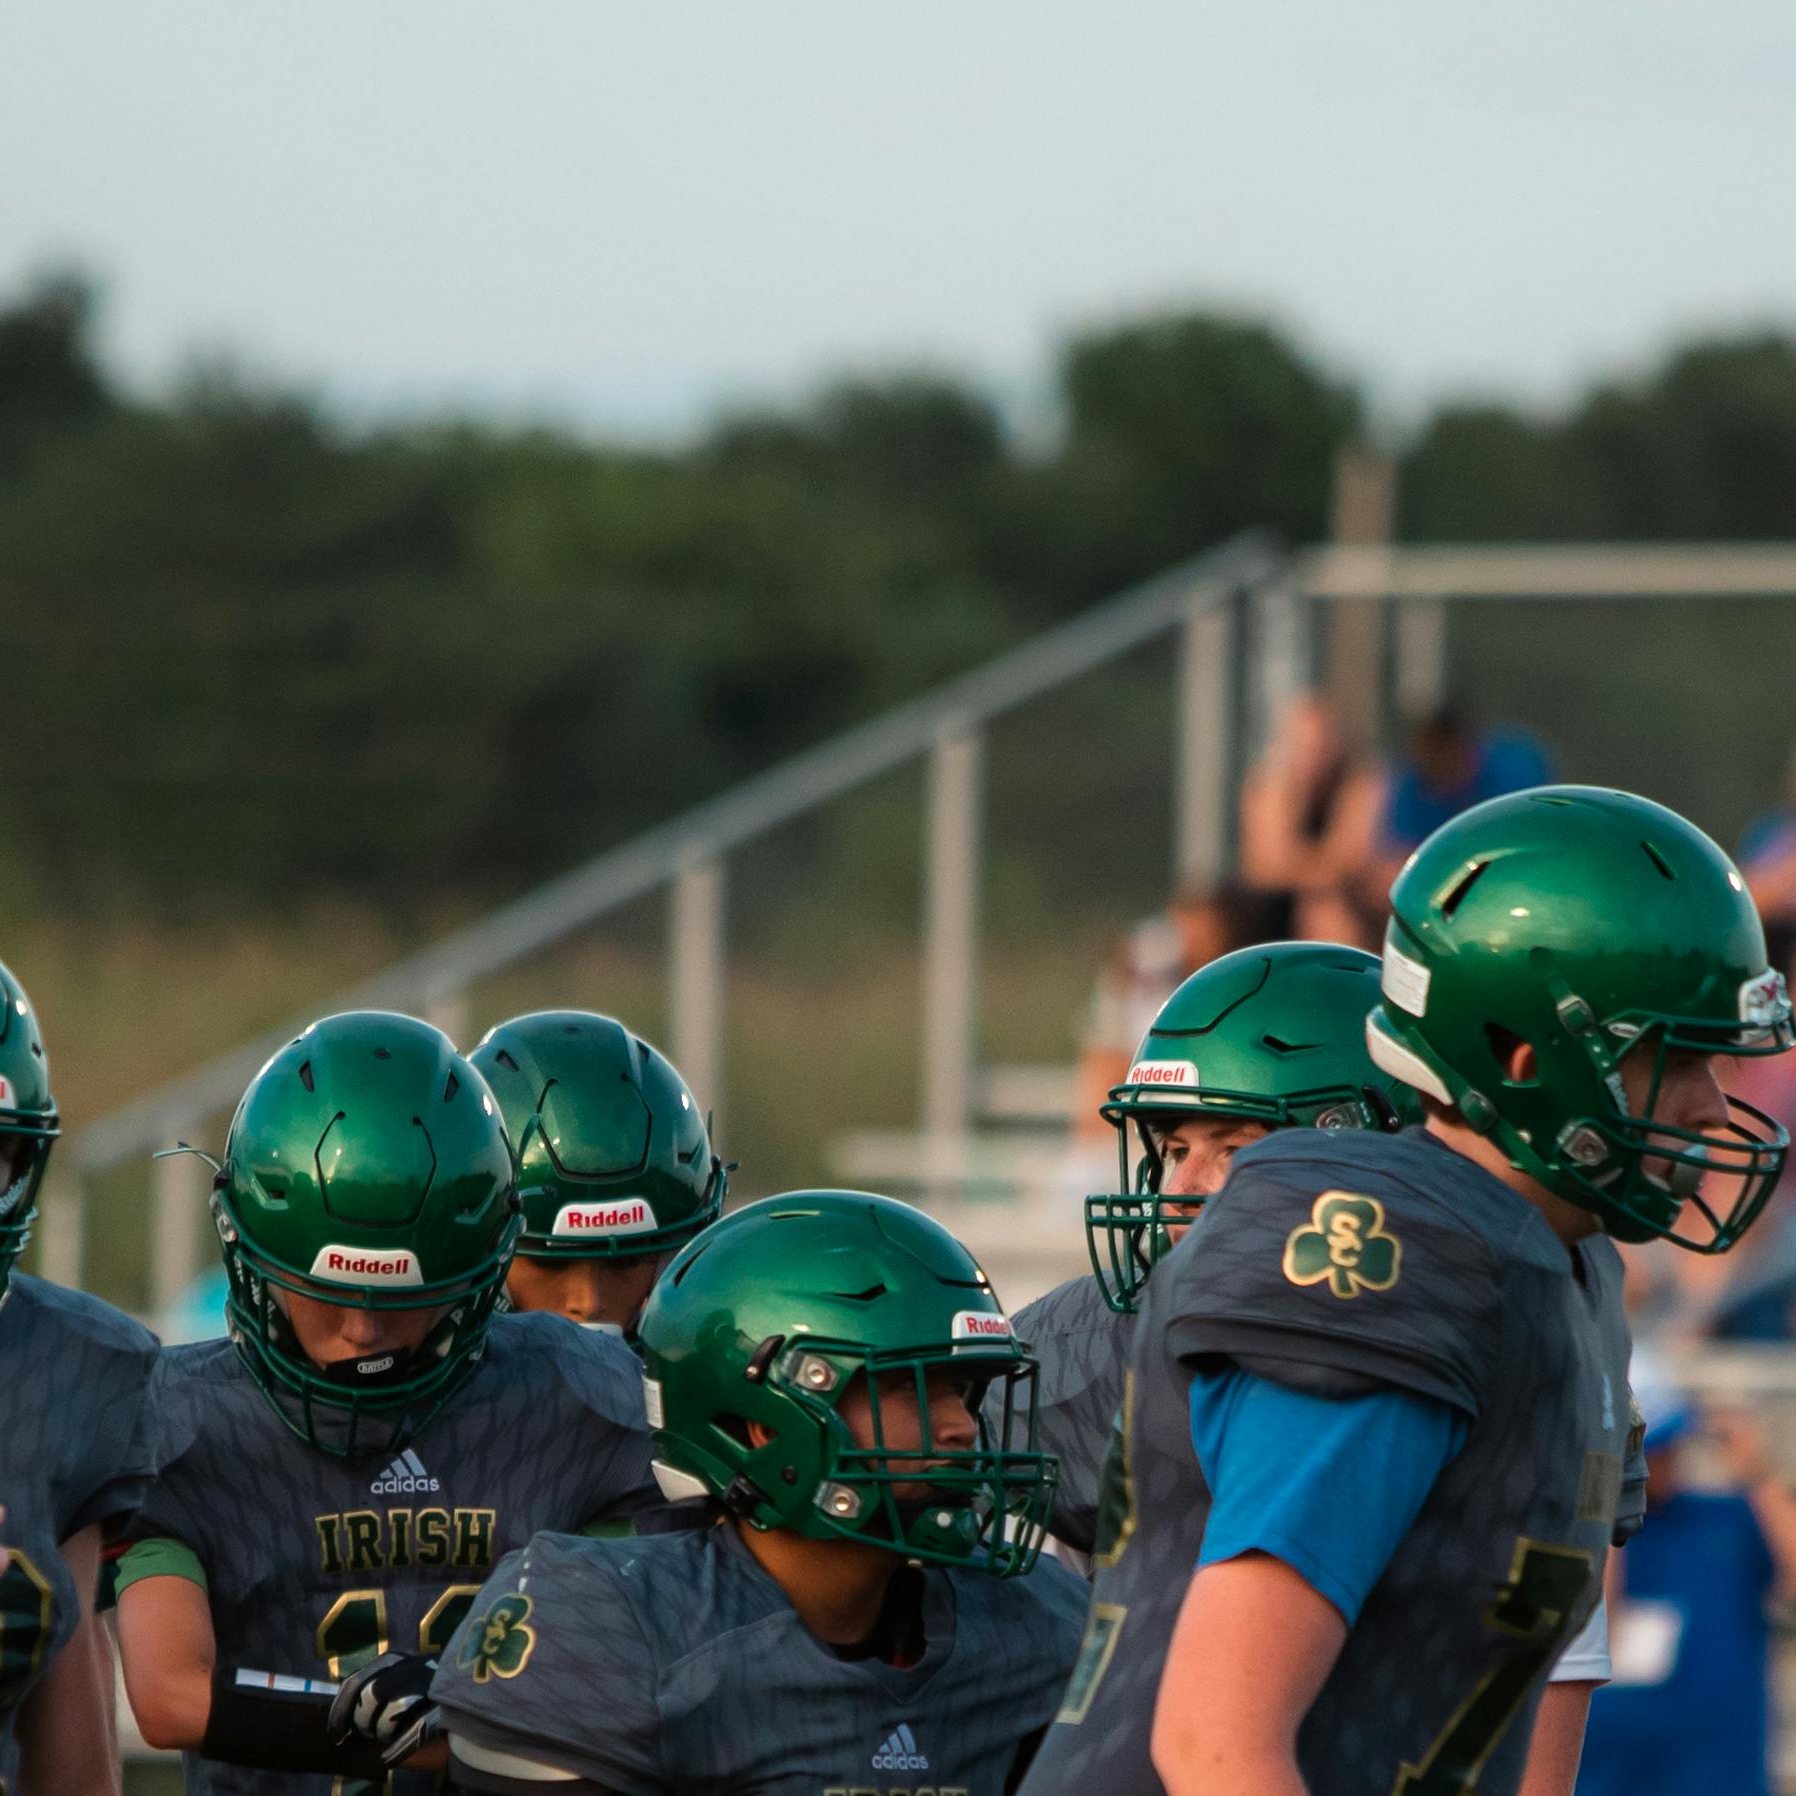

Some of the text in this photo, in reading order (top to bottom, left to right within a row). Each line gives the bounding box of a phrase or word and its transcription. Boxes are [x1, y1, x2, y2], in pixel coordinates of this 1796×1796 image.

[1133, 1066, 1185, 1083] Riddell
[567, 1206, 644, 1229] Riddell
[328, 1253, 408, 1275] Riddell
[370, 1475, 440, 1494] adidas
[315, 1507, 496, 1574] IRISH
[871, 1750, 929, 1770] adidas
